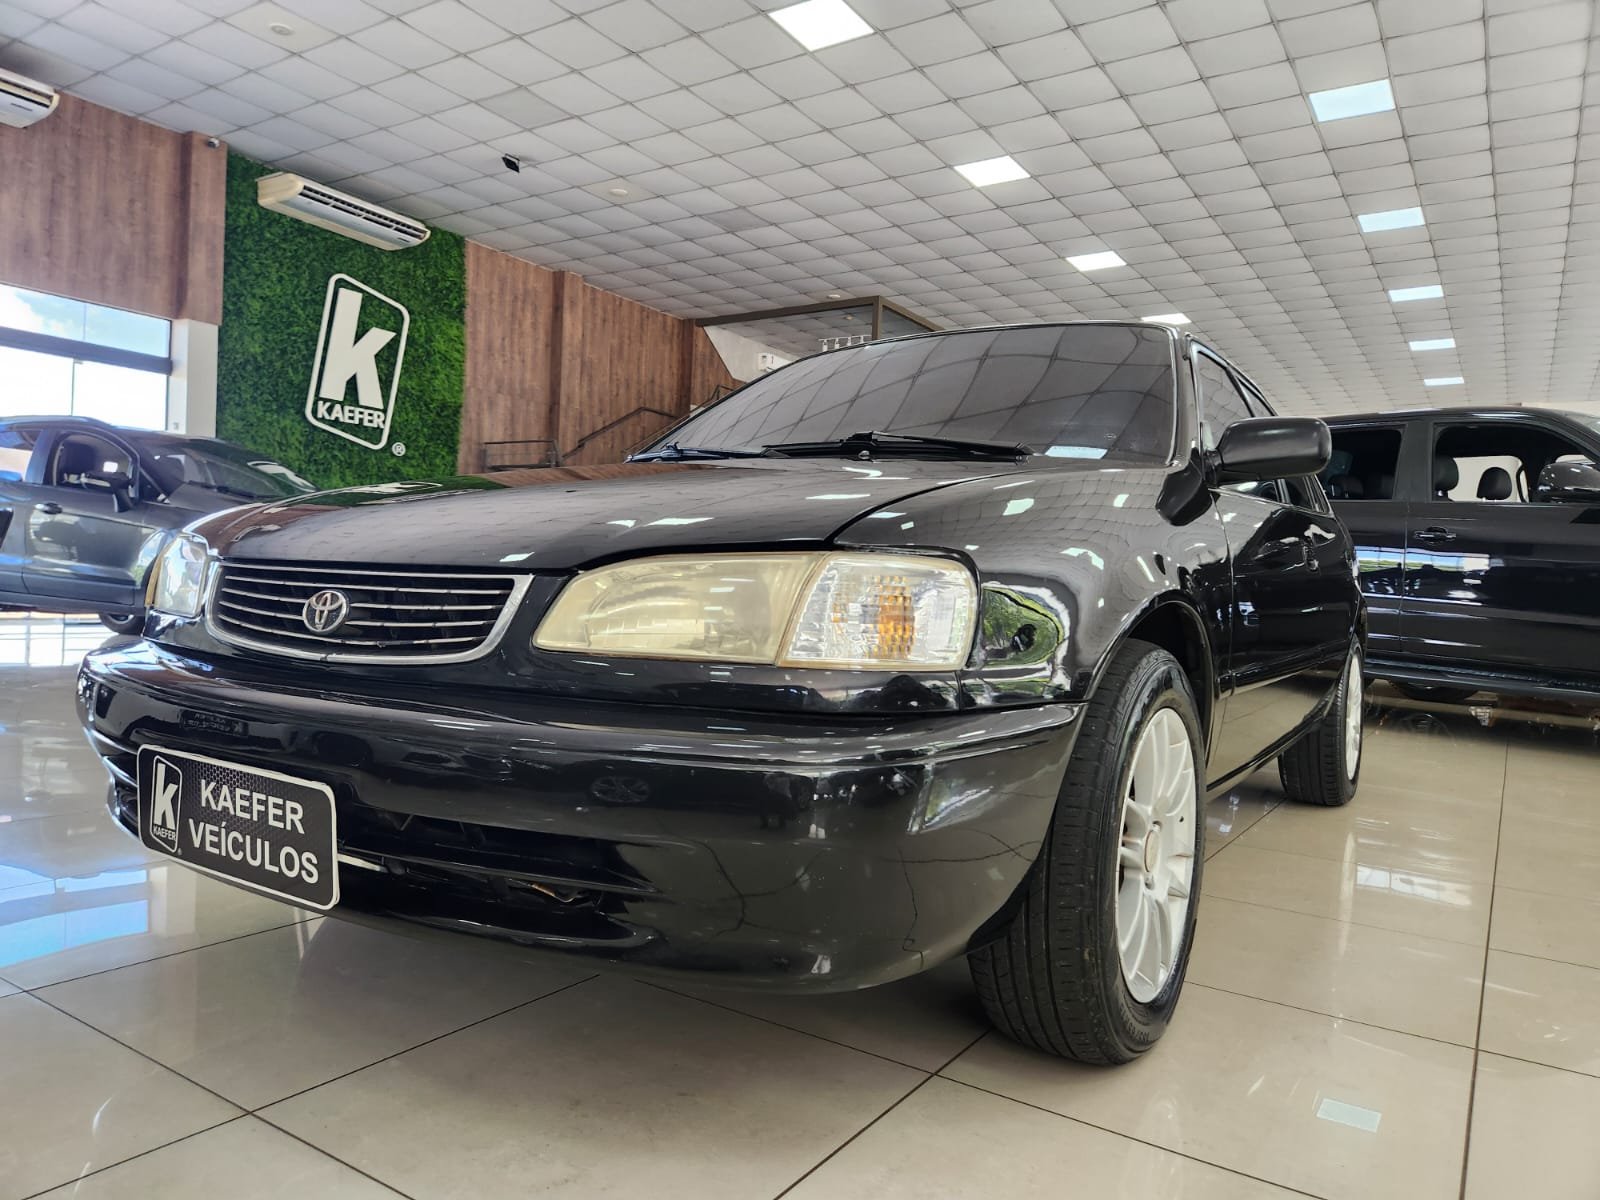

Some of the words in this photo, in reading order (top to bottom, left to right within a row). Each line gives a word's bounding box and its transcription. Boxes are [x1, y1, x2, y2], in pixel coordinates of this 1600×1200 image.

[317, 400, 385, 429] KAEFER
[201, 779, 305, 834] KAEFER
[152, 825, 177, 841] KAEFER
[188, 818, 319, 884] VEÍCULOS
